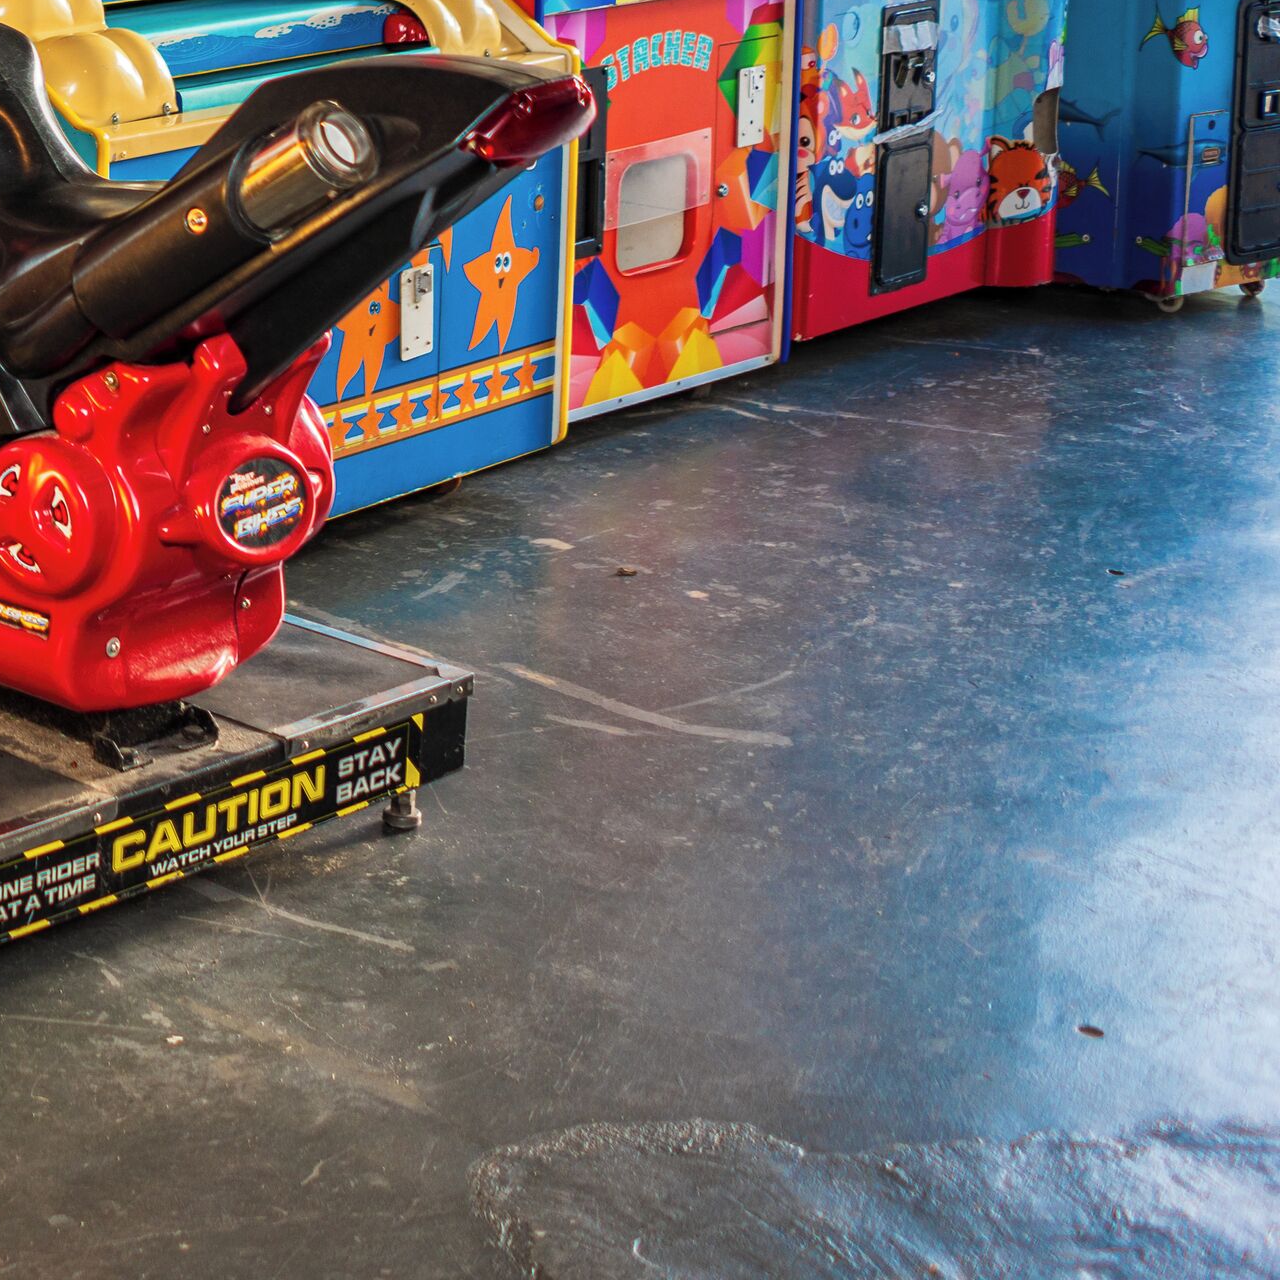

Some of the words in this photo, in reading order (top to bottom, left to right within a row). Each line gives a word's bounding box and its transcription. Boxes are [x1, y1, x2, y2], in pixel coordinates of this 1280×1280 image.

[224, 474, 296, 516] SUPER
[336, 736, 402, 780] STAY
[335, 762, 402, 806] BACK
[111, 764, 327, 874] CAUTION
[150, 844, 211, 878] WATCH
[213, 827, 256, 860] YOUR
[257, 812, 299, 844] STEP
[36, 851, 101, 889] RIDER
[20, 893, 43, 917] A
[44, 873, 96, 909] TIME
